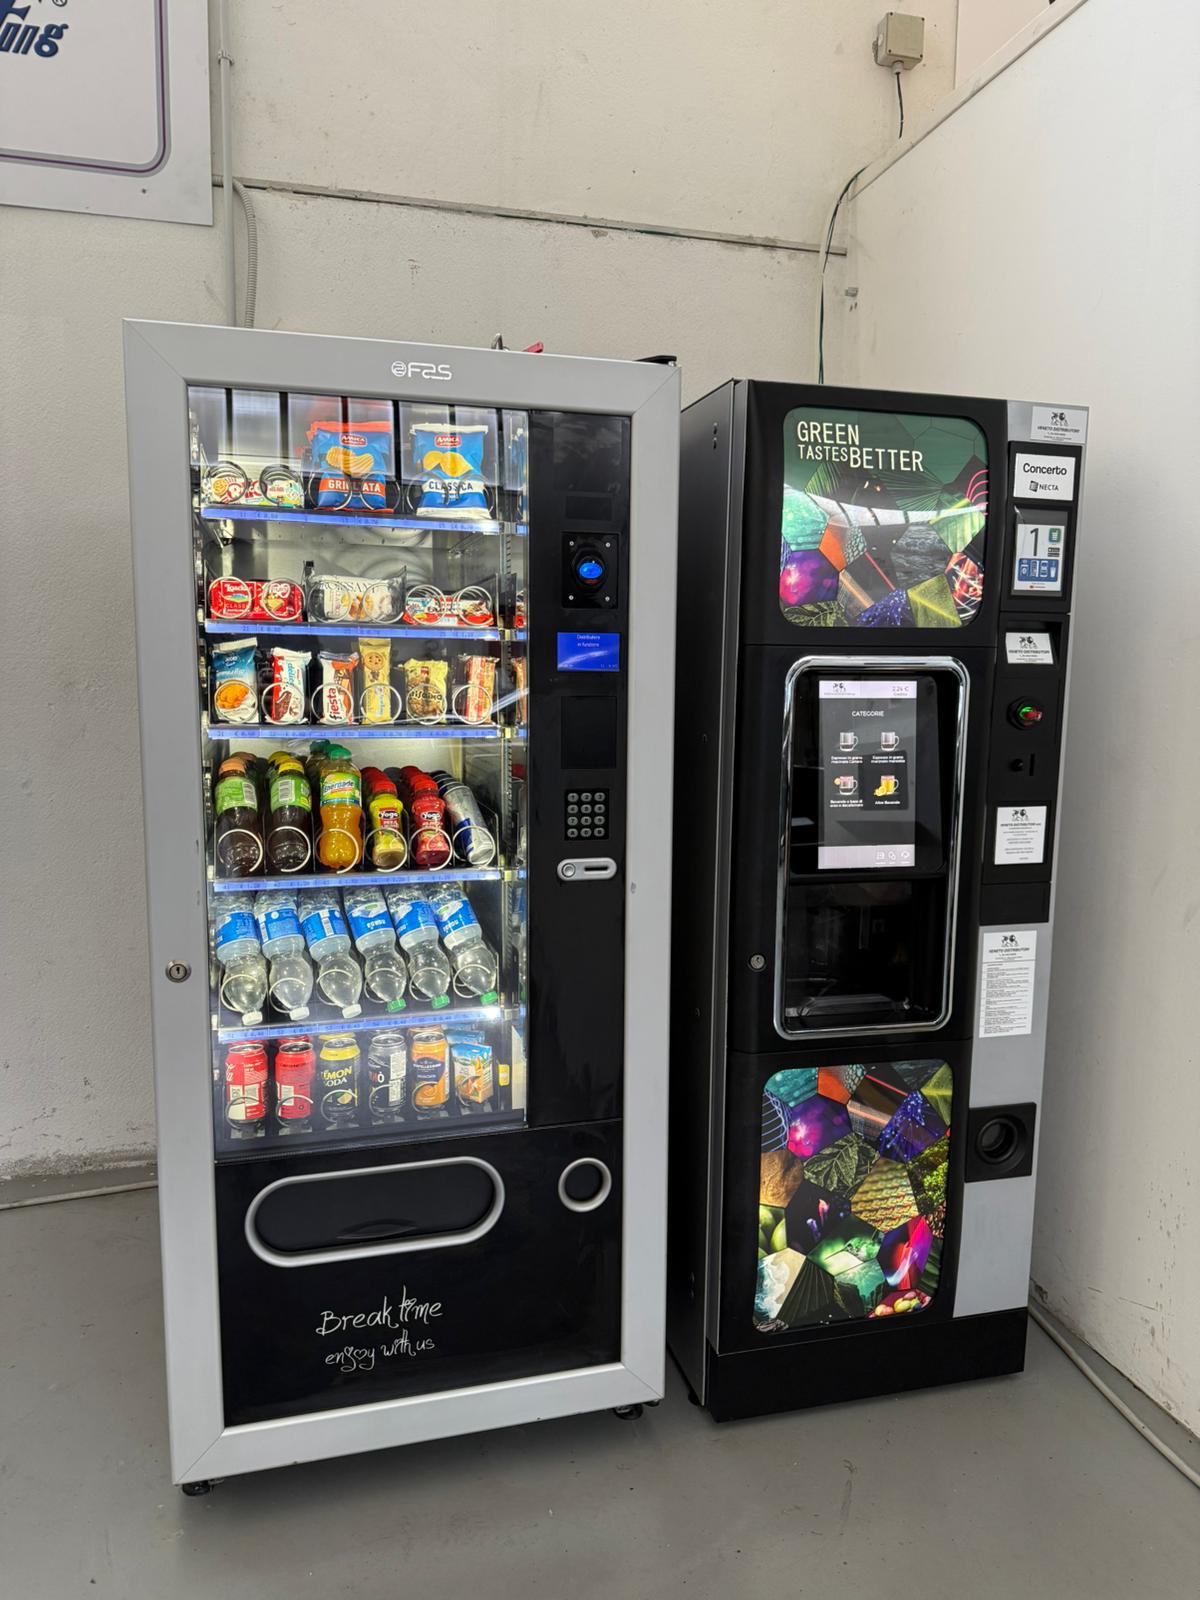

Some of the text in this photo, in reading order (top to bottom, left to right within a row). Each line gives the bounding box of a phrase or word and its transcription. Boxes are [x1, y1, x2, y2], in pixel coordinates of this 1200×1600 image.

[797, 421, 860, 445] GREEN
[797, 445, 924, 471] TASTES BETTER
[1023, 463, 1067, 475] Concerto
[1030, 528, 1039, 556] 1
[327, 688, 342, 720] fiesta
[316, 1285, 443, 1336] Break time
[325, 1328, 435, 1372] enjoy with us
